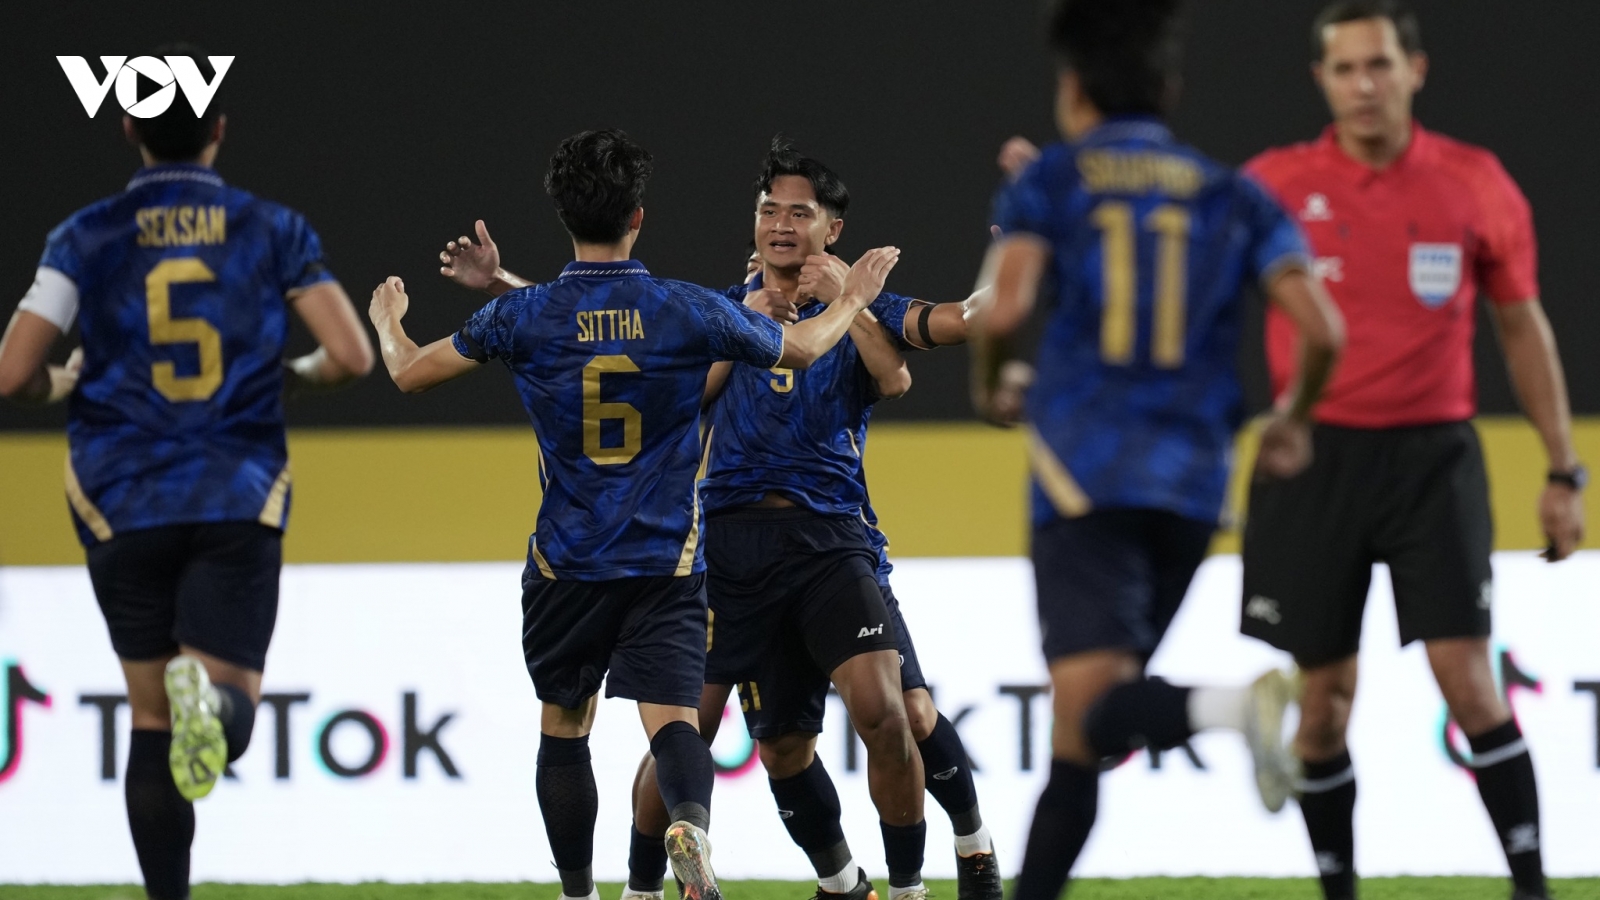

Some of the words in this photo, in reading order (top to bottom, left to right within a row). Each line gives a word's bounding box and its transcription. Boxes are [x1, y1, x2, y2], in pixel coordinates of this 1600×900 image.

[136, 205, 226, 247] SEKSAN
[576, 309, 645, 342] SITTHA
[1092, 203, 1190, 367] 11
[146, 257, 223, 402] 5
[582, 354, 642, 466] 6
[857, 623, 884, 638] Ari
[79, 691, 461, 779] TTok
